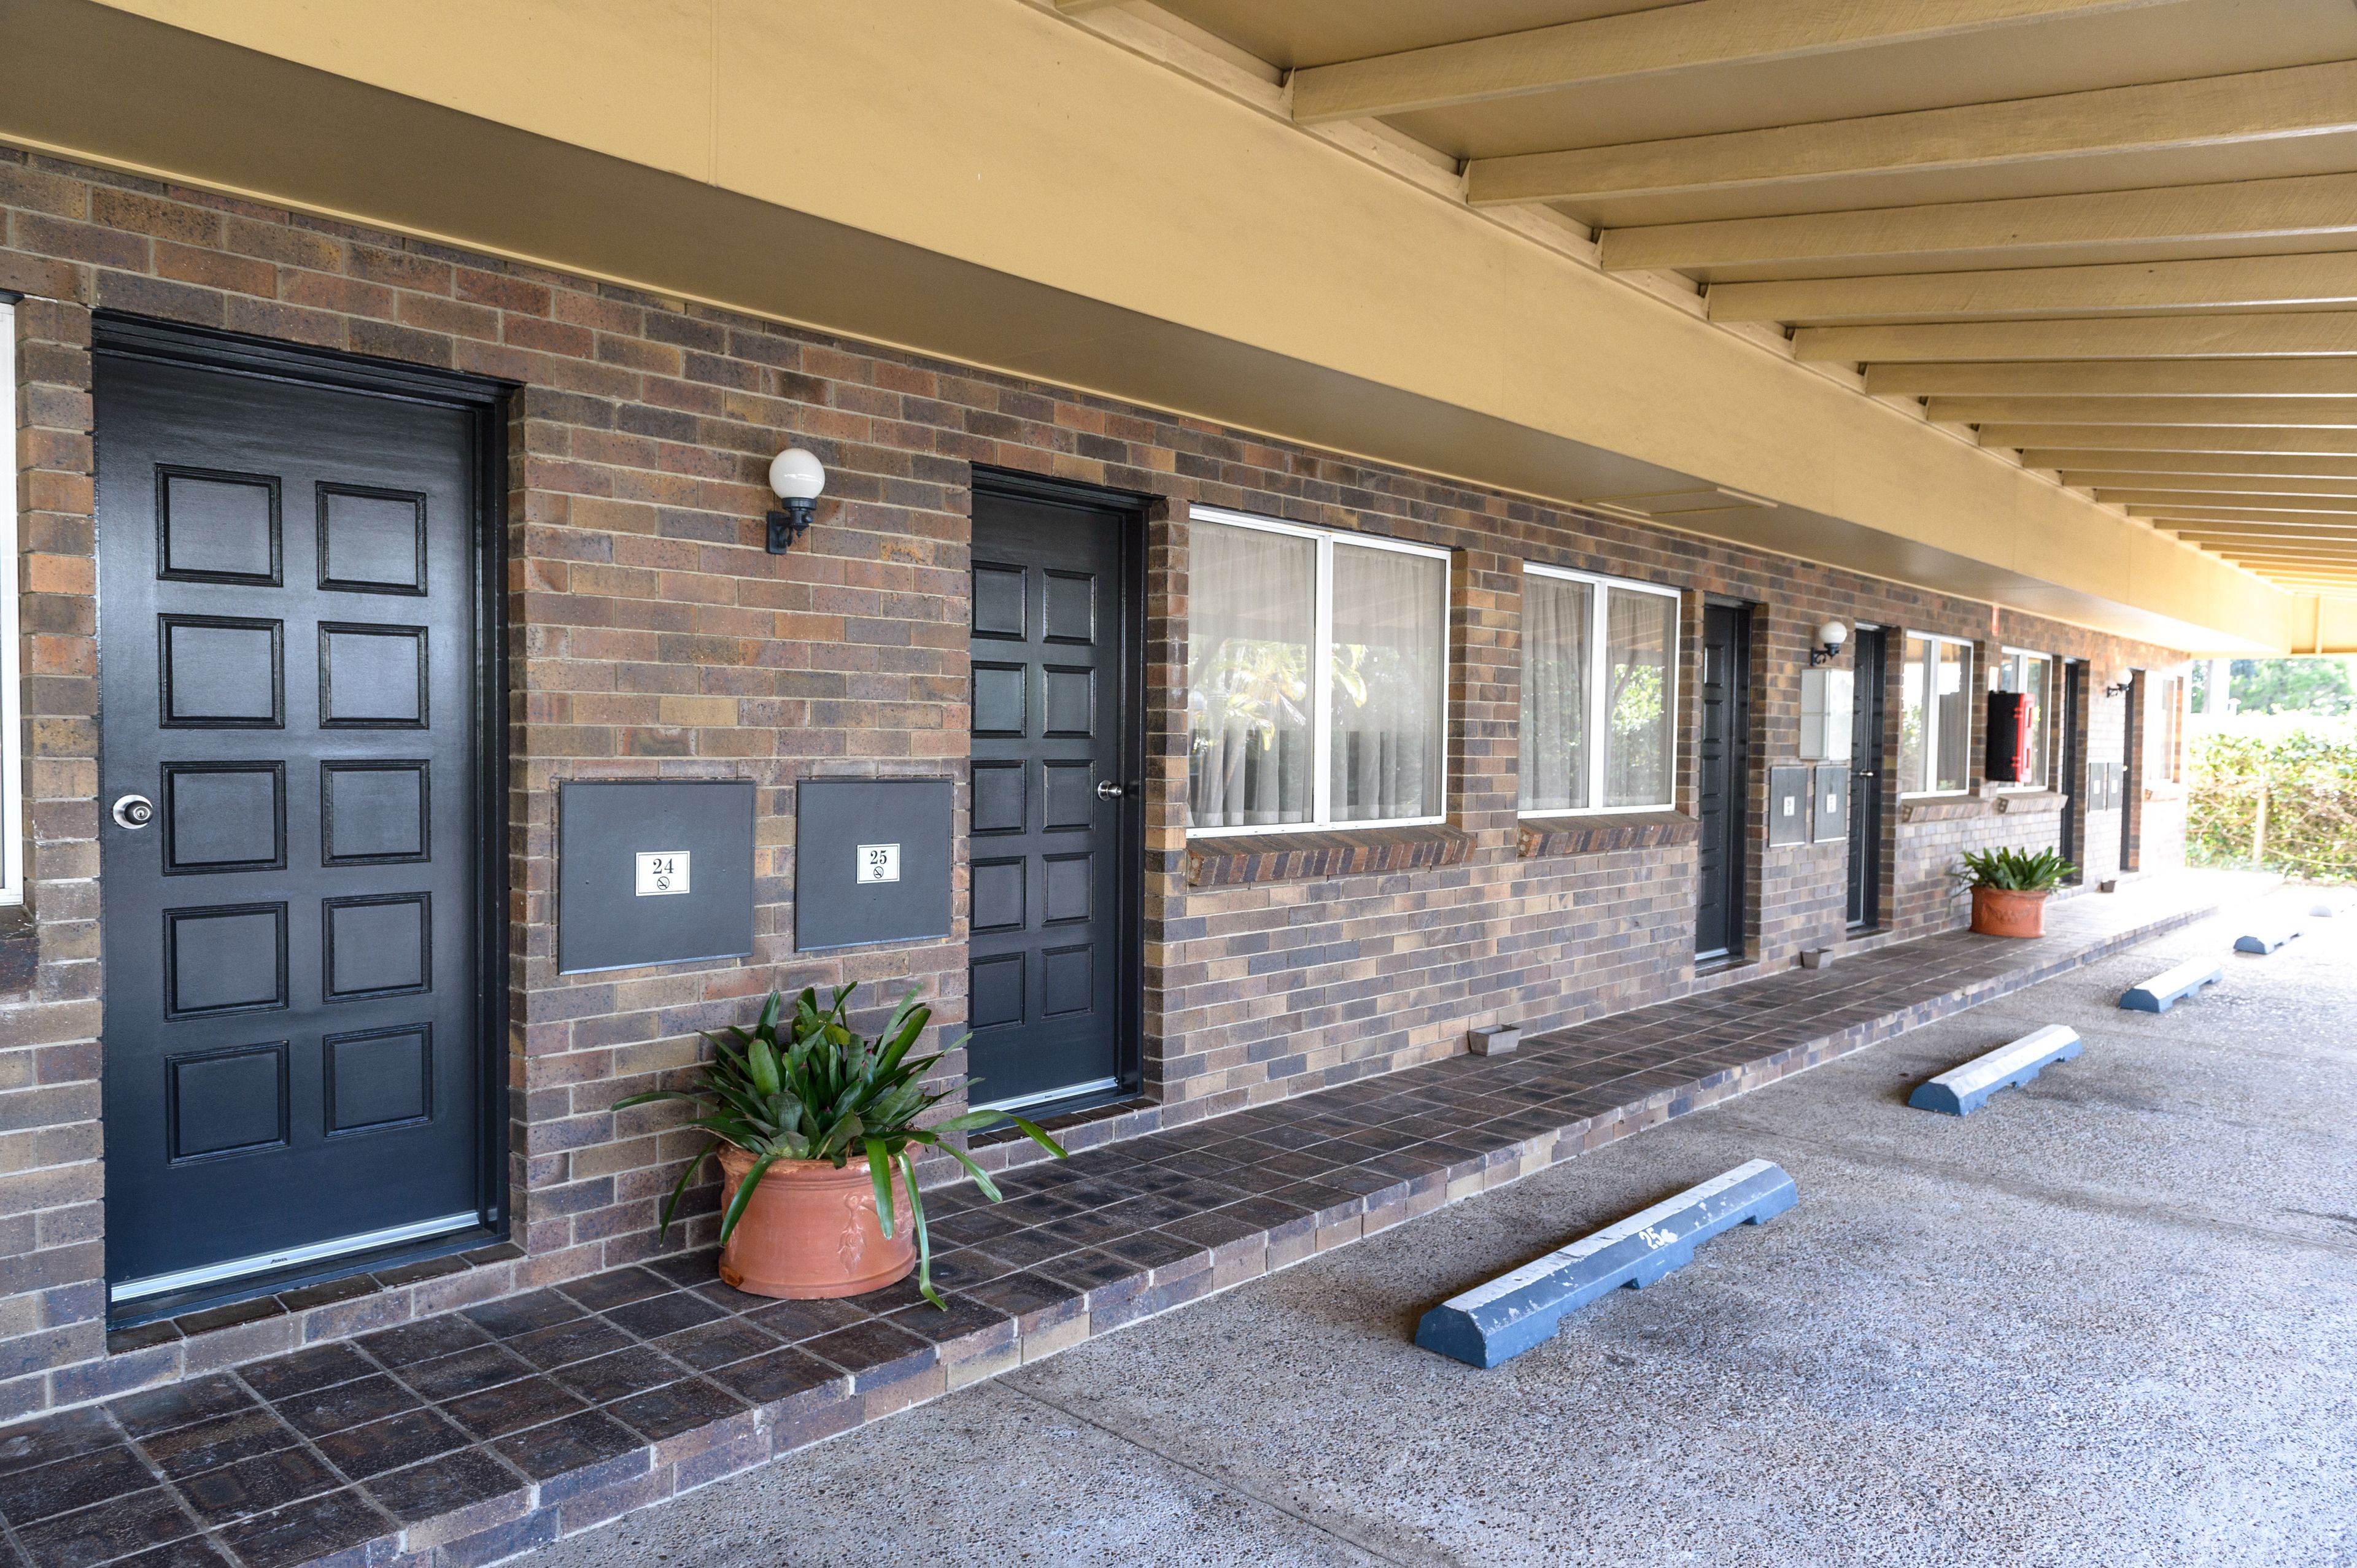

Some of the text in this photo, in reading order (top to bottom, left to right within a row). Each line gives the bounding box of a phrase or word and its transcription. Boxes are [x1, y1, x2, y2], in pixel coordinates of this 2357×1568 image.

[870, 850, 887, 865] 25
[652, 858, 674, 875] 24
[1639, 1227, 1665, 1249] 25
